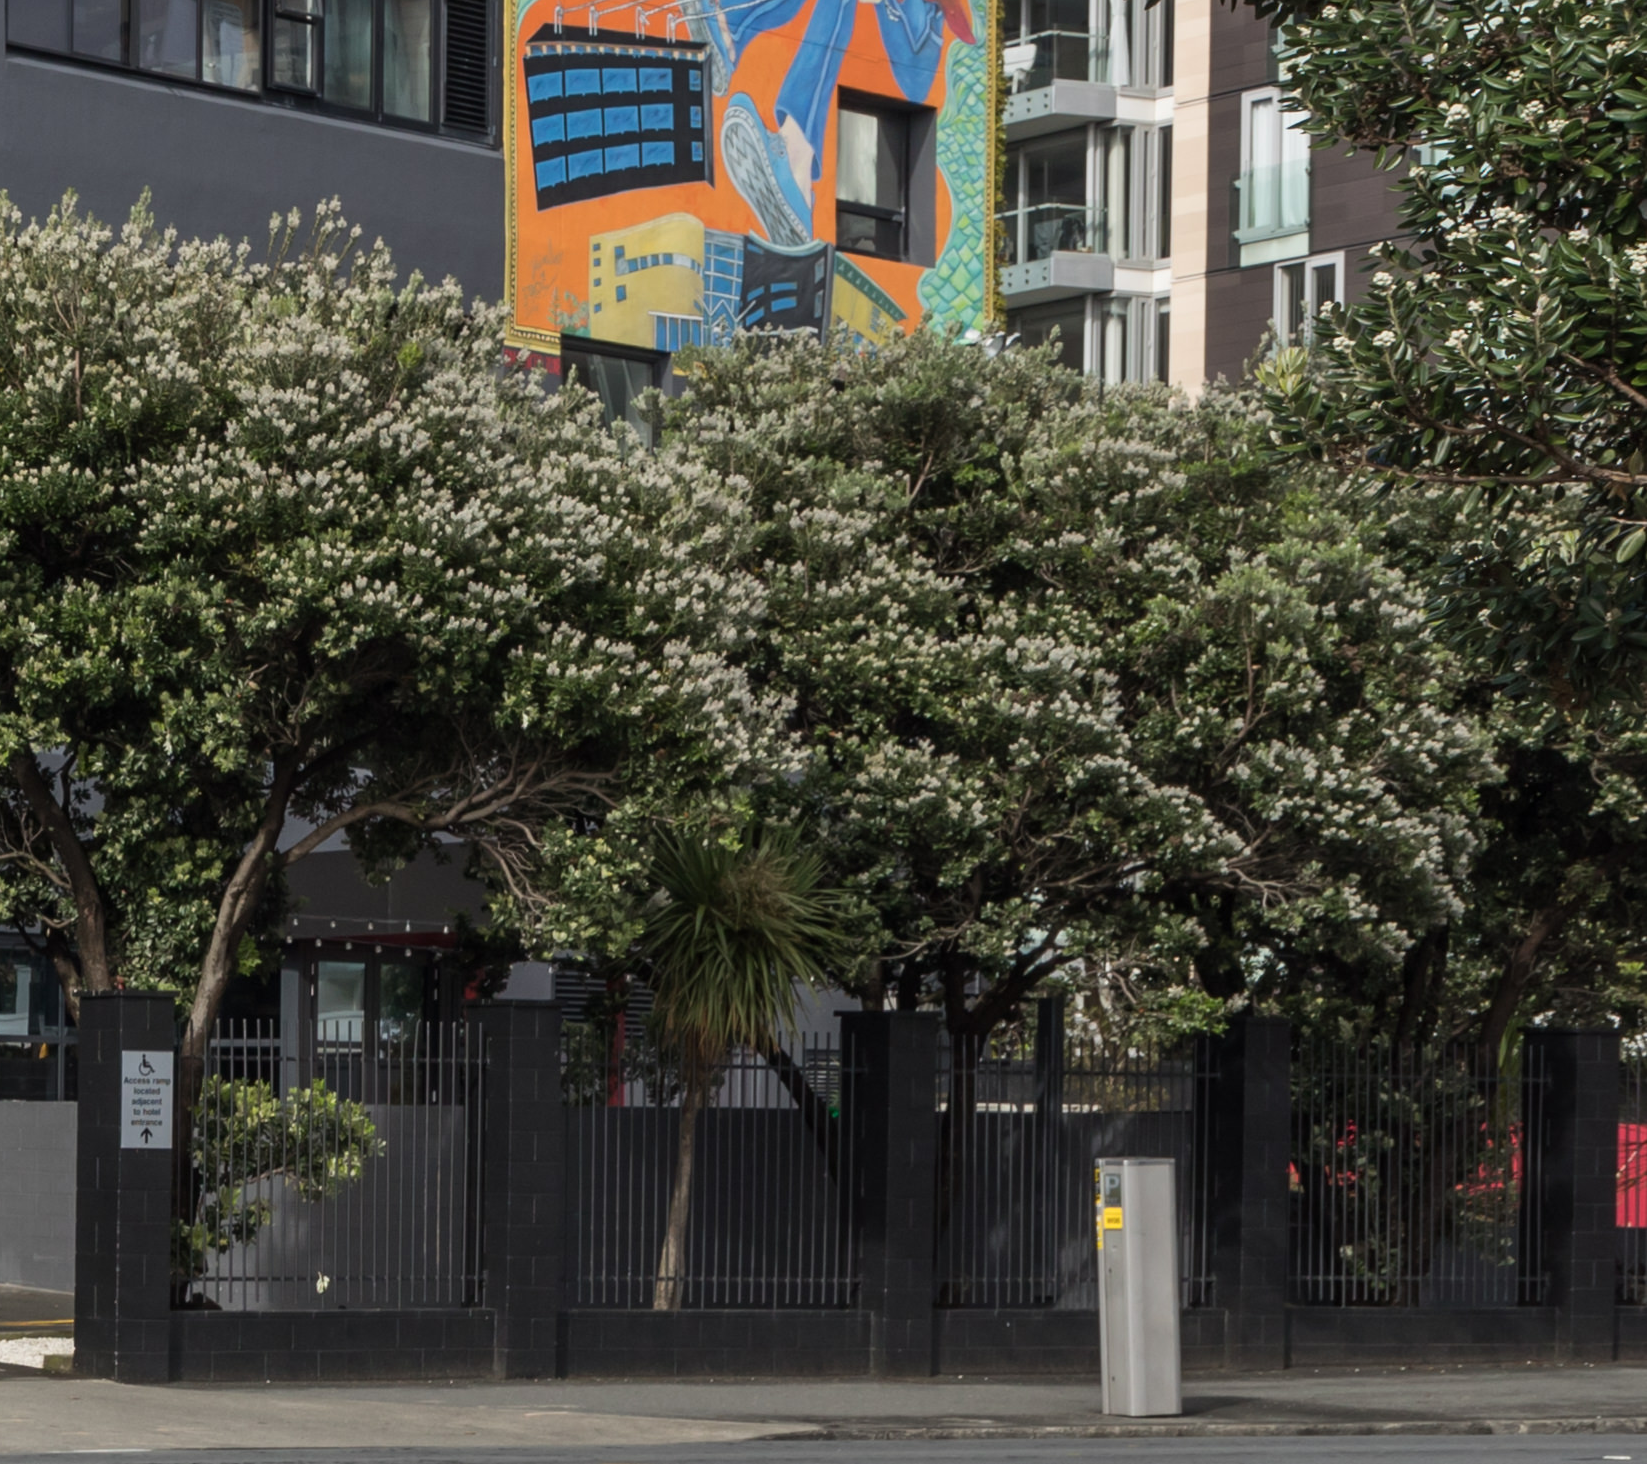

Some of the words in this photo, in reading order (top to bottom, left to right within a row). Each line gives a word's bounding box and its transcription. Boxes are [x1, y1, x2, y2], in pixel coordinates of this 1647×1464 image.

[123, 1077, 151, 1085] Access
[152, 1078, 171, 1086] ramp
[133, 1087, 161, 1095] located
[131, 1098, 163, 1106] adjacent
[133, 1108, 141, 1116] to
[142, 1108, 161, 1116] hotel
[1105, 1175, 1120, 1195] P
